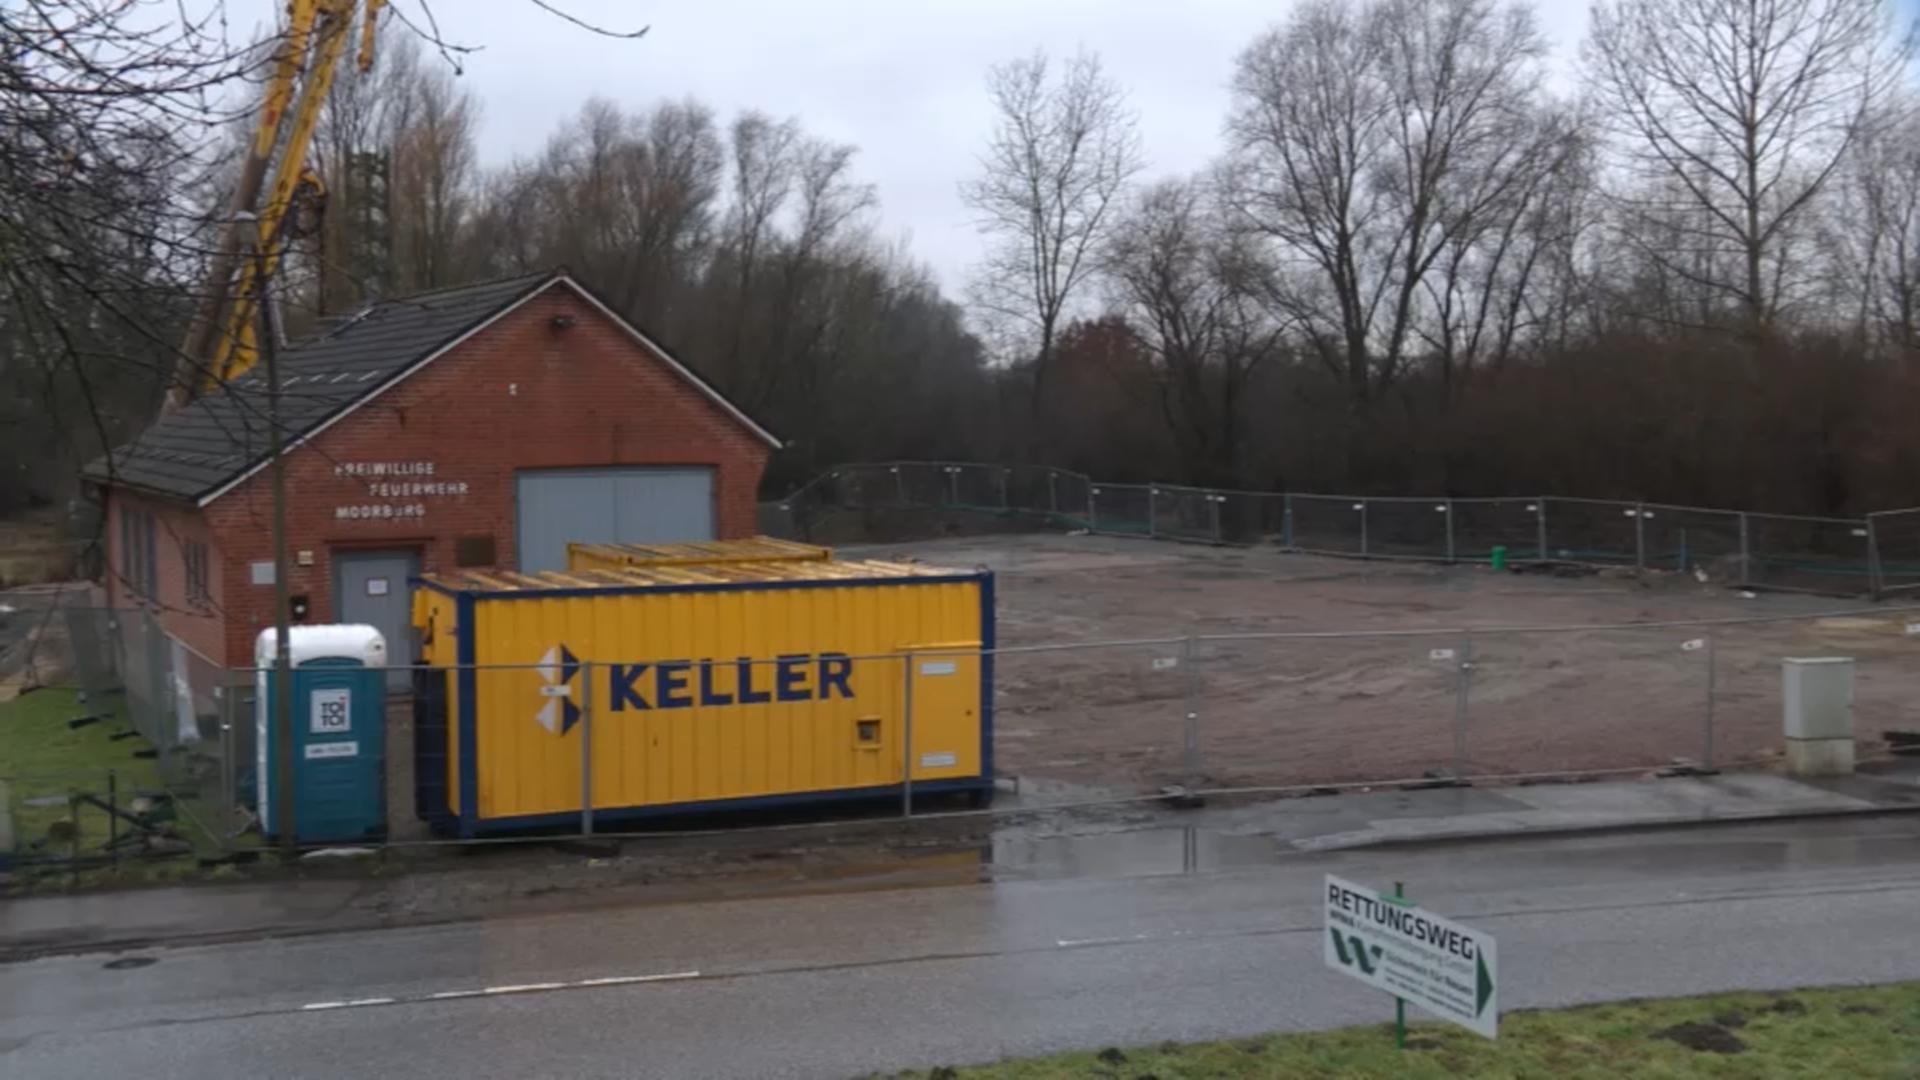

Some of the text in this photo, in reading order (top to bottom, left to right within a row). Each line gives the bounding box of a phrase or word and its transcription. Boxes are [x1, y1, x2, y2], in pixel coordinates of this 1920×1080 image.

[369, 482, 469, 497] FEUERWEHR
[610, 652, 855, 712] KELLER
[321, 714, 346, 727] TOI
[1329, 884, 1473, 960] RETTUNGSWEG
